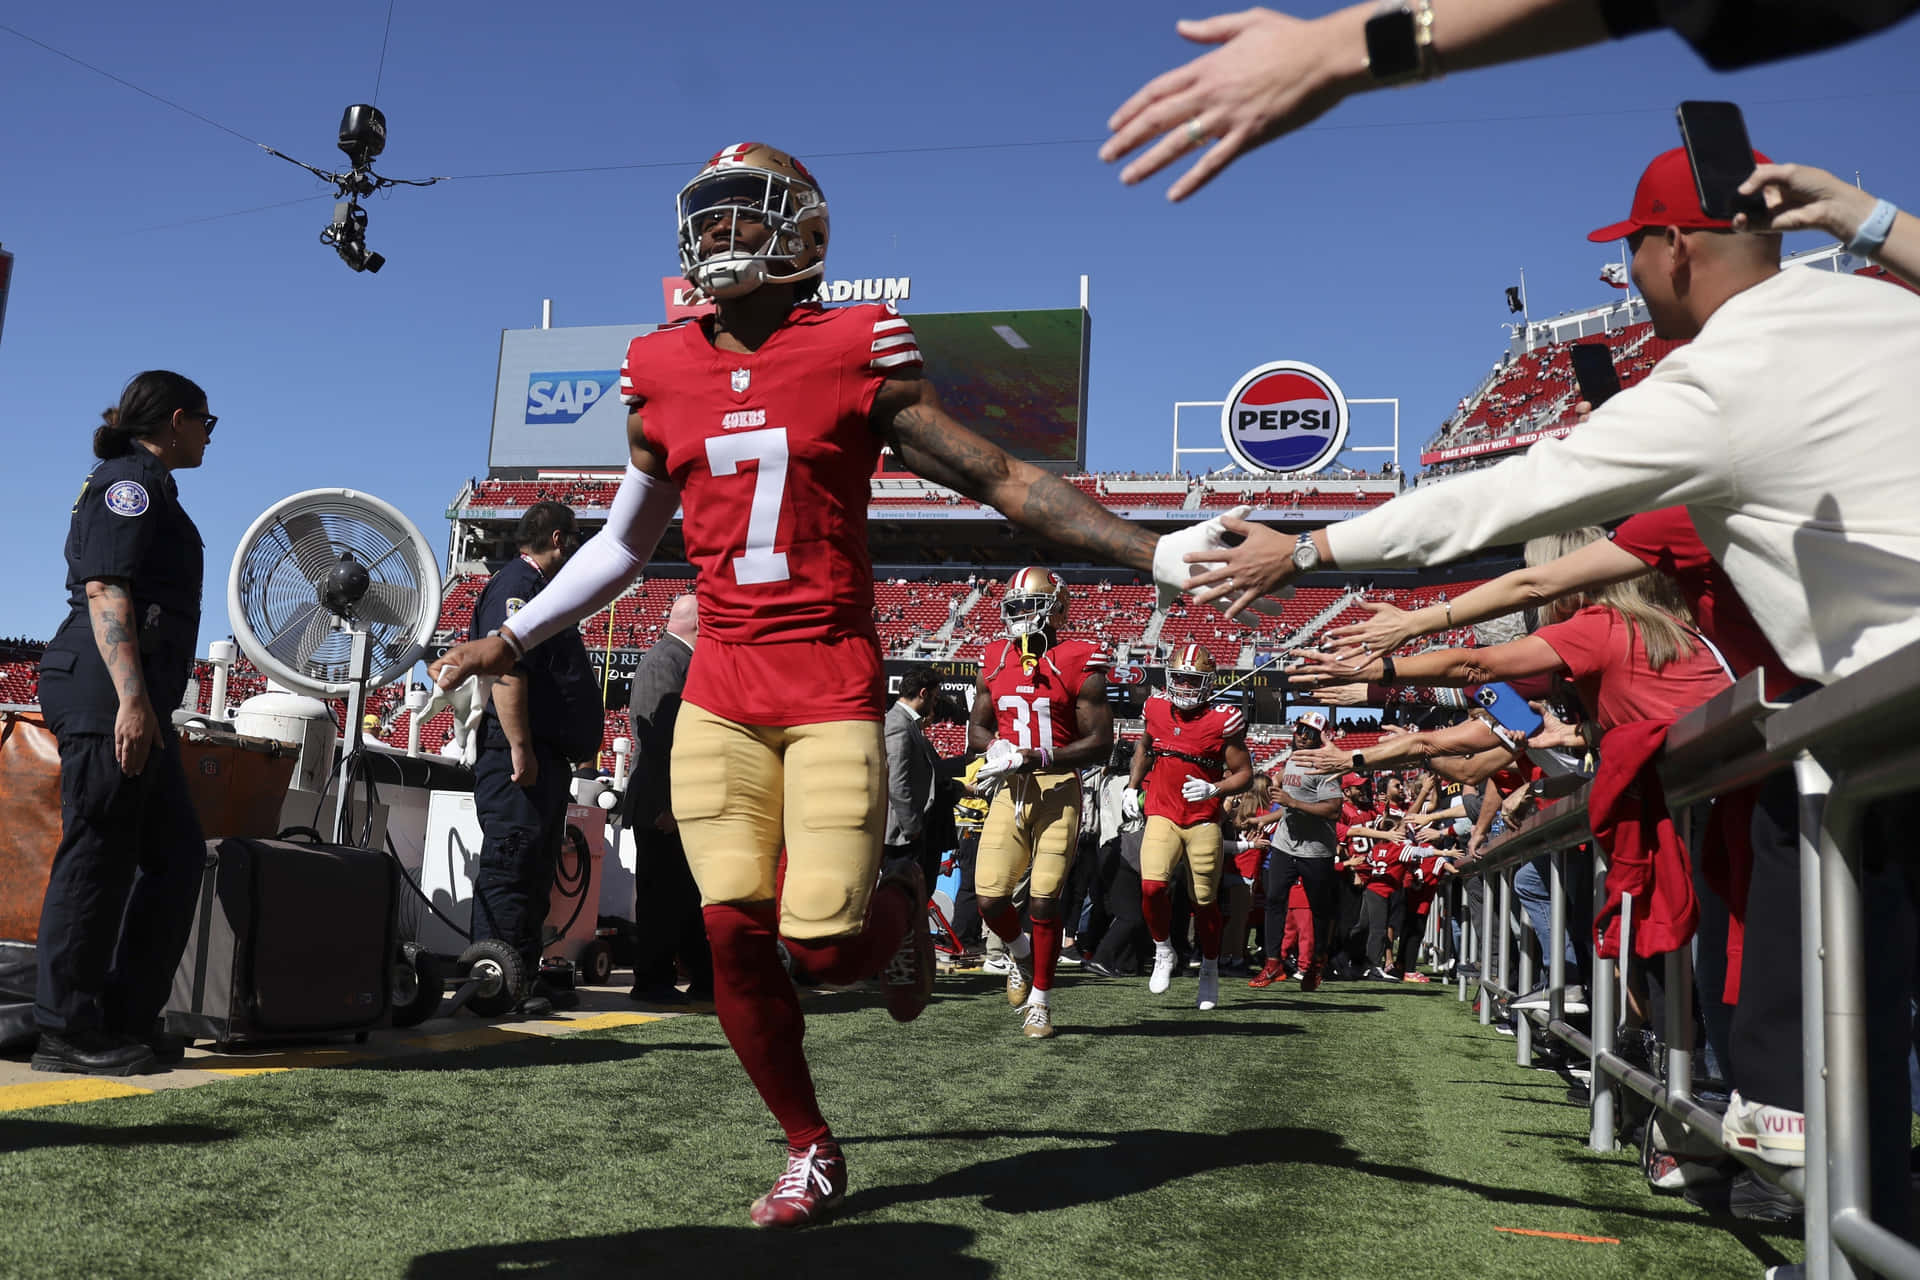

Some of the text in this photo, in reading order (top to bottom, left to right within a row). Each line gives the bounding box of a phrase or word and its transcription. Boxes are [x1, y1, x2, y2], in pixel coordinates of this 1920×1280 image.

[804, 277, 910, 303] ADIUM
[528, 380, 601, 415] SAP
[721, 410, 766, 429] 49ERS
[1238, 410, 1330, 430] PEPSI
[1441, 450, 1459, 459] FREE
[1460, 442, 1490, 455] XFINITY
[1515, 433, 1537, 444] NEED
[704, 427, 790, 586] 7
[939, 682, 976, 691] TOYOTA
[1253, 673, 1268, 687] in
[998, 695, 1052, 751] 31
[1762, 1115, 1804, 1133] VUIT
